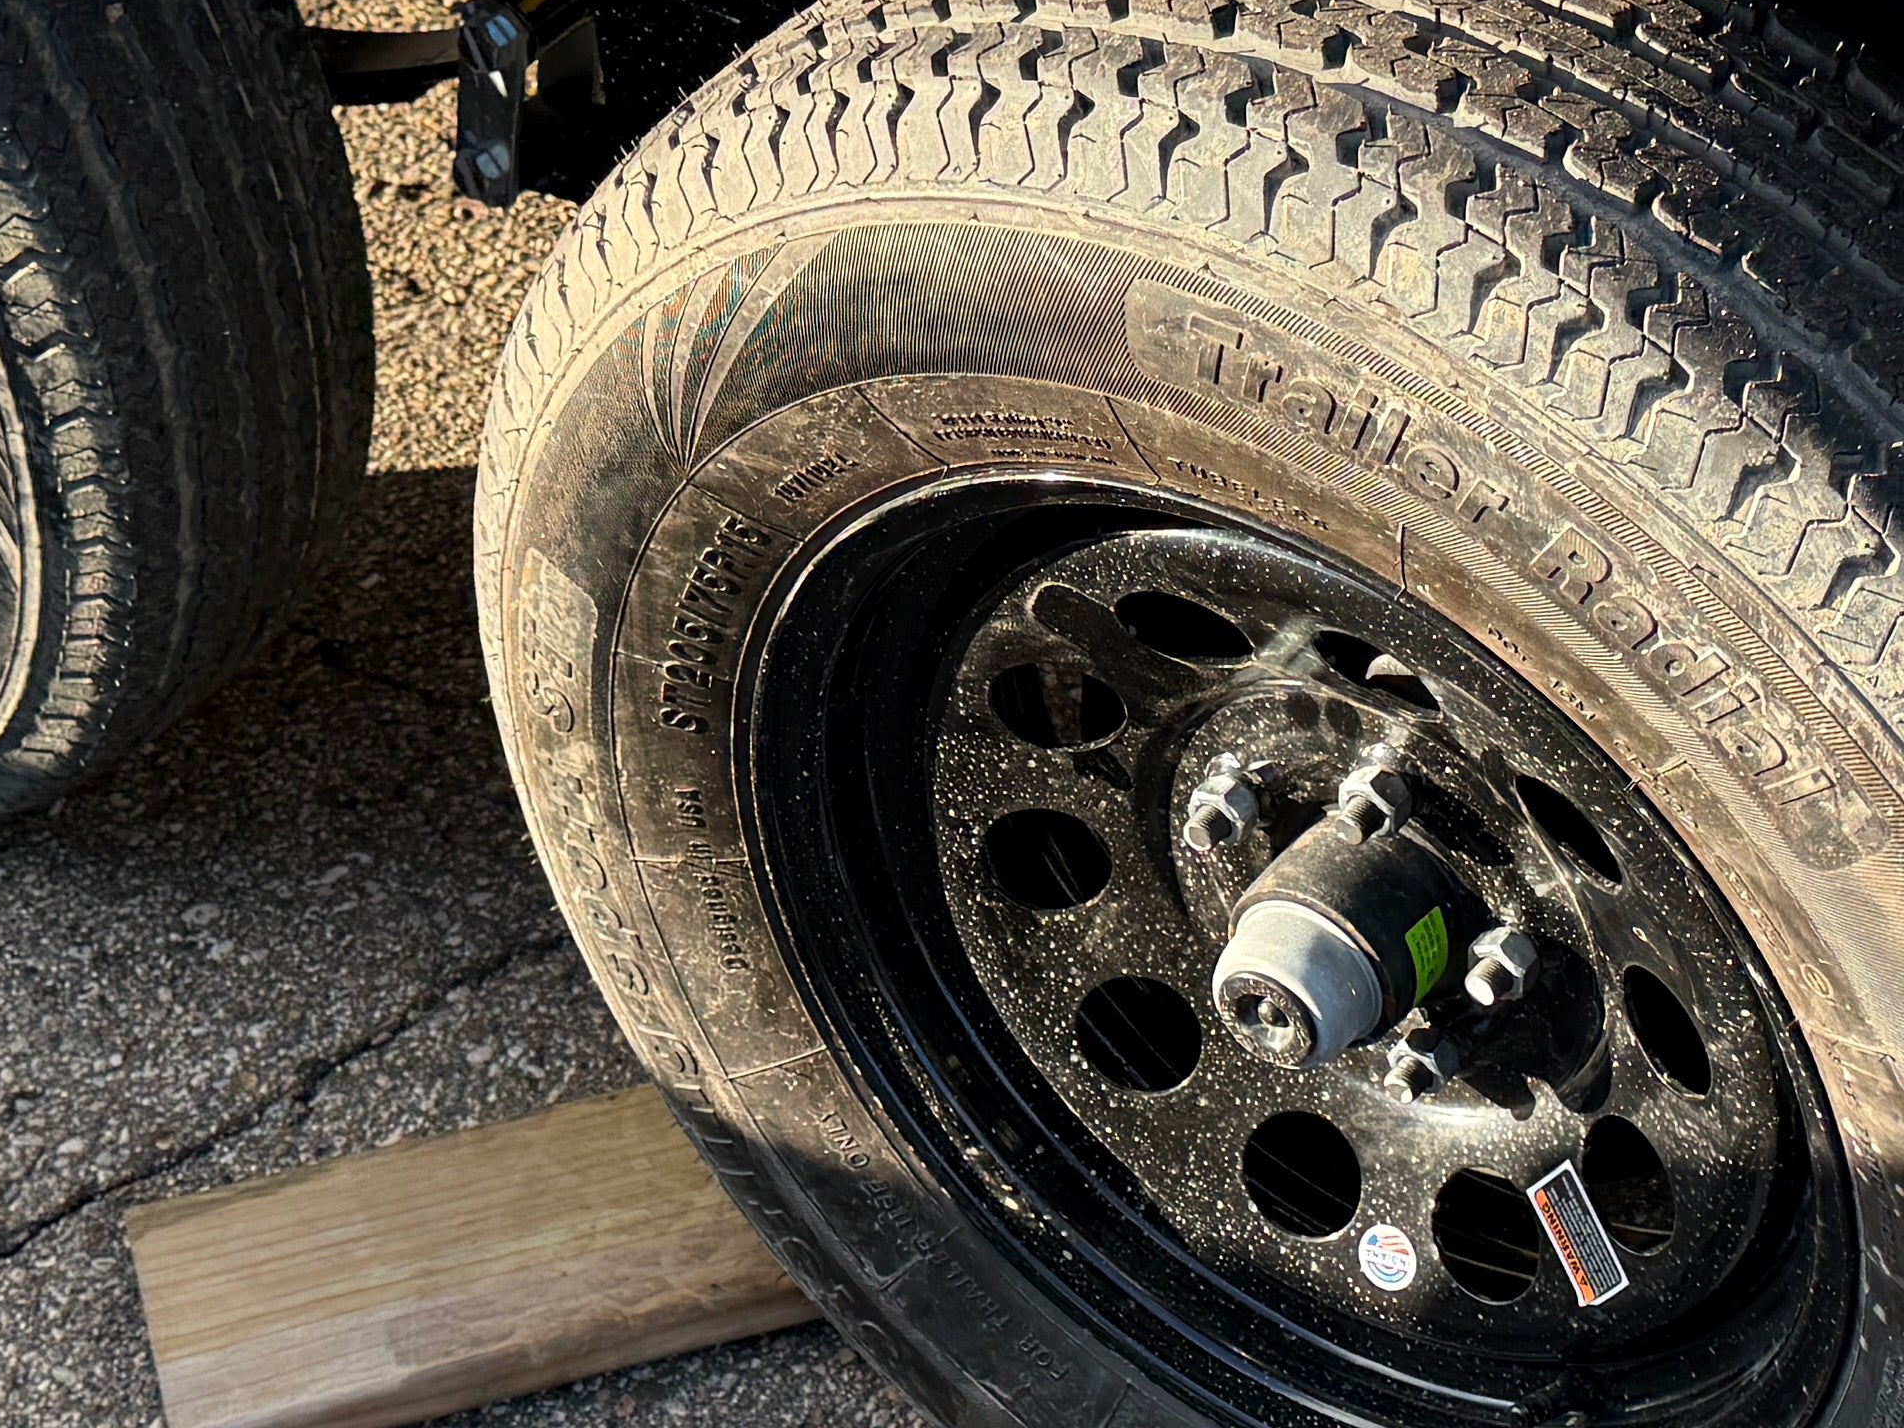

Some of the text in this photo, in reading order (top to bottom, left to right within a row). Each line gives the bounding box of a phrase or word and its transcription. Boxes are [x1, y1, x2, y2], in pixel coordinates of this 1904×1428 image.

[1187, 312, 1836, 808] Trailer Radial
[655, 494, 774, 748] ST205/75R15
[669, 775, 711, 836] USA
[809, 1105, 875, 1173] ONLY
[1542, 1199, 1583, 1277] WARNING
